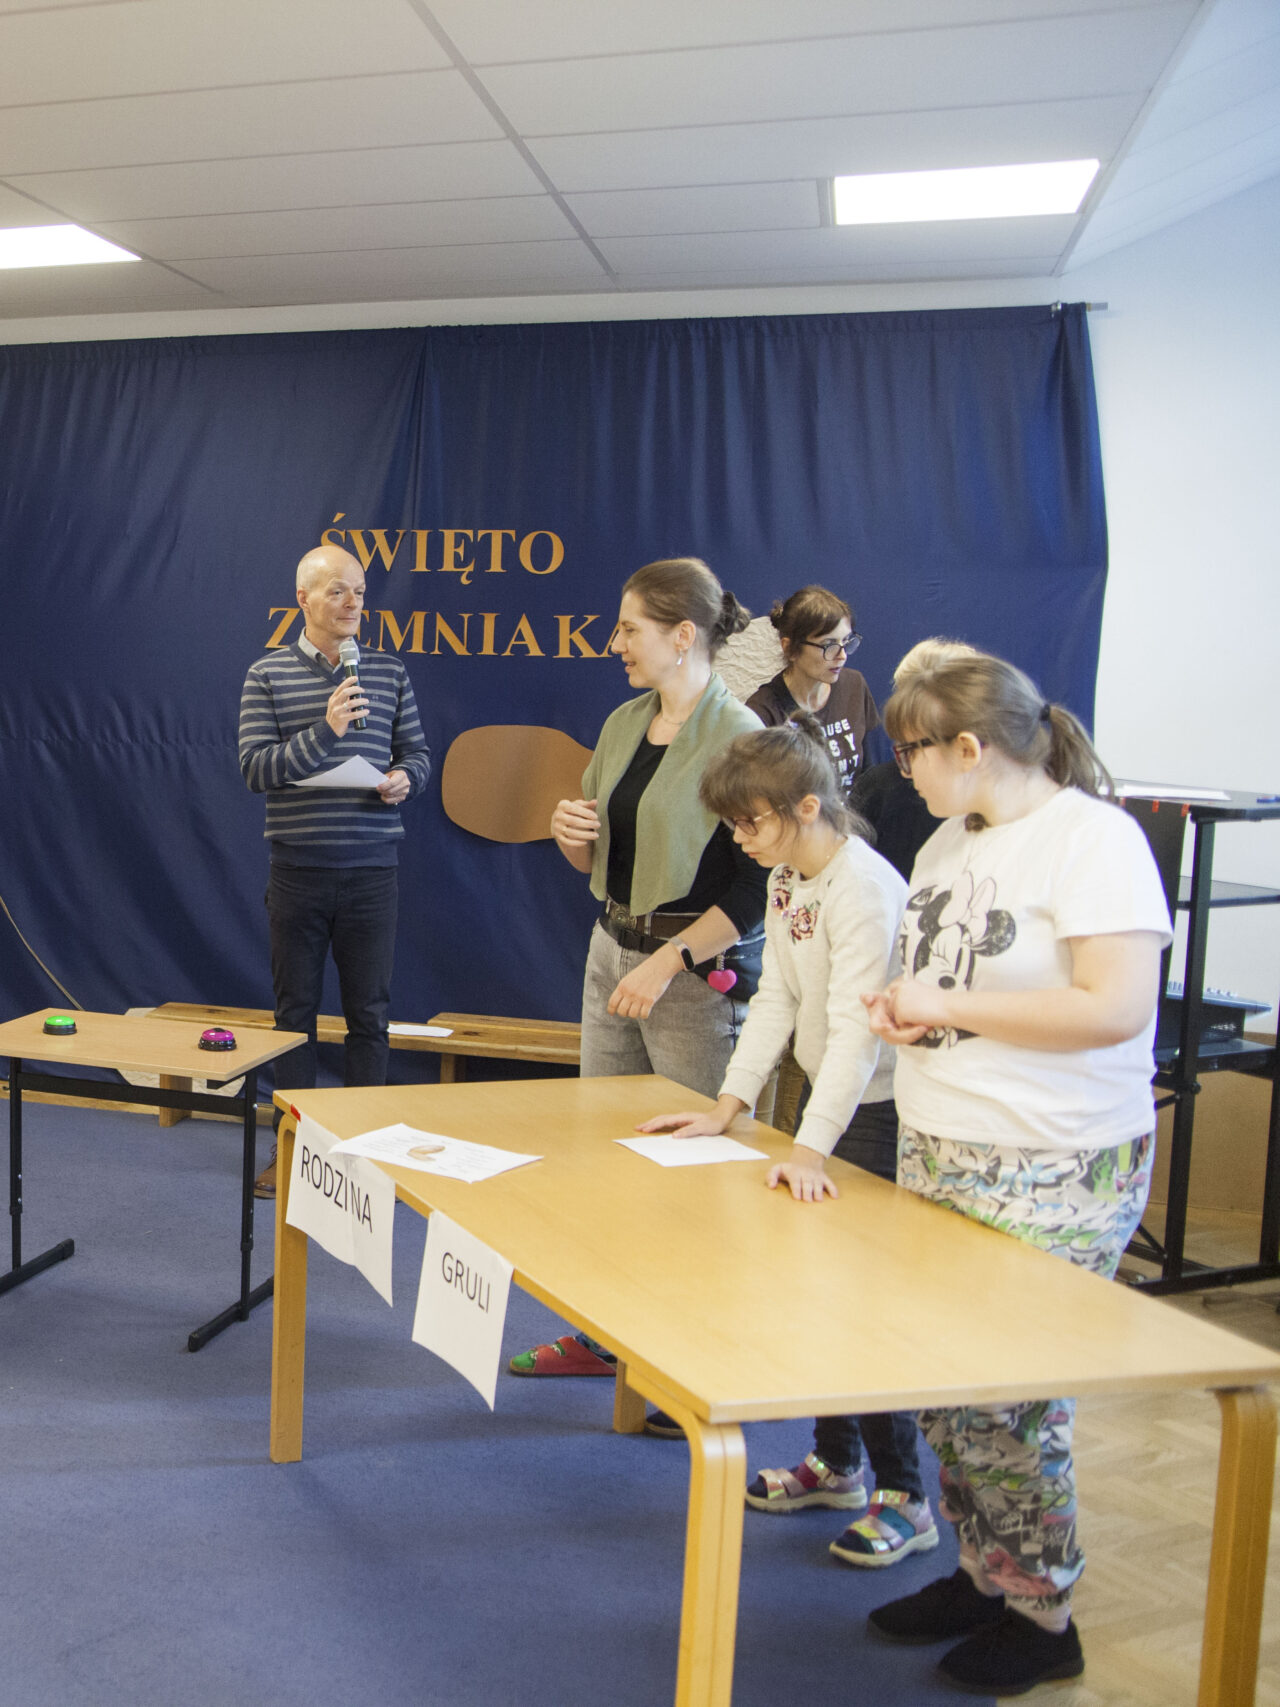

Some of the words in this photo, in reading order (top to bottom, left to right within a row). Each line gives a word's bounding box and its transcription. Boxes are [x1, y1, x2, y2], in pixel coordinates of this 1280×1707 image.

[320, 512, 565, 585] ŚWIĘTO
[264, 607, 621, 658] ZMNIAK
[300, 1145, 373, 1234] RODZINA
[441, 1251, 490, 1314] GRULI
